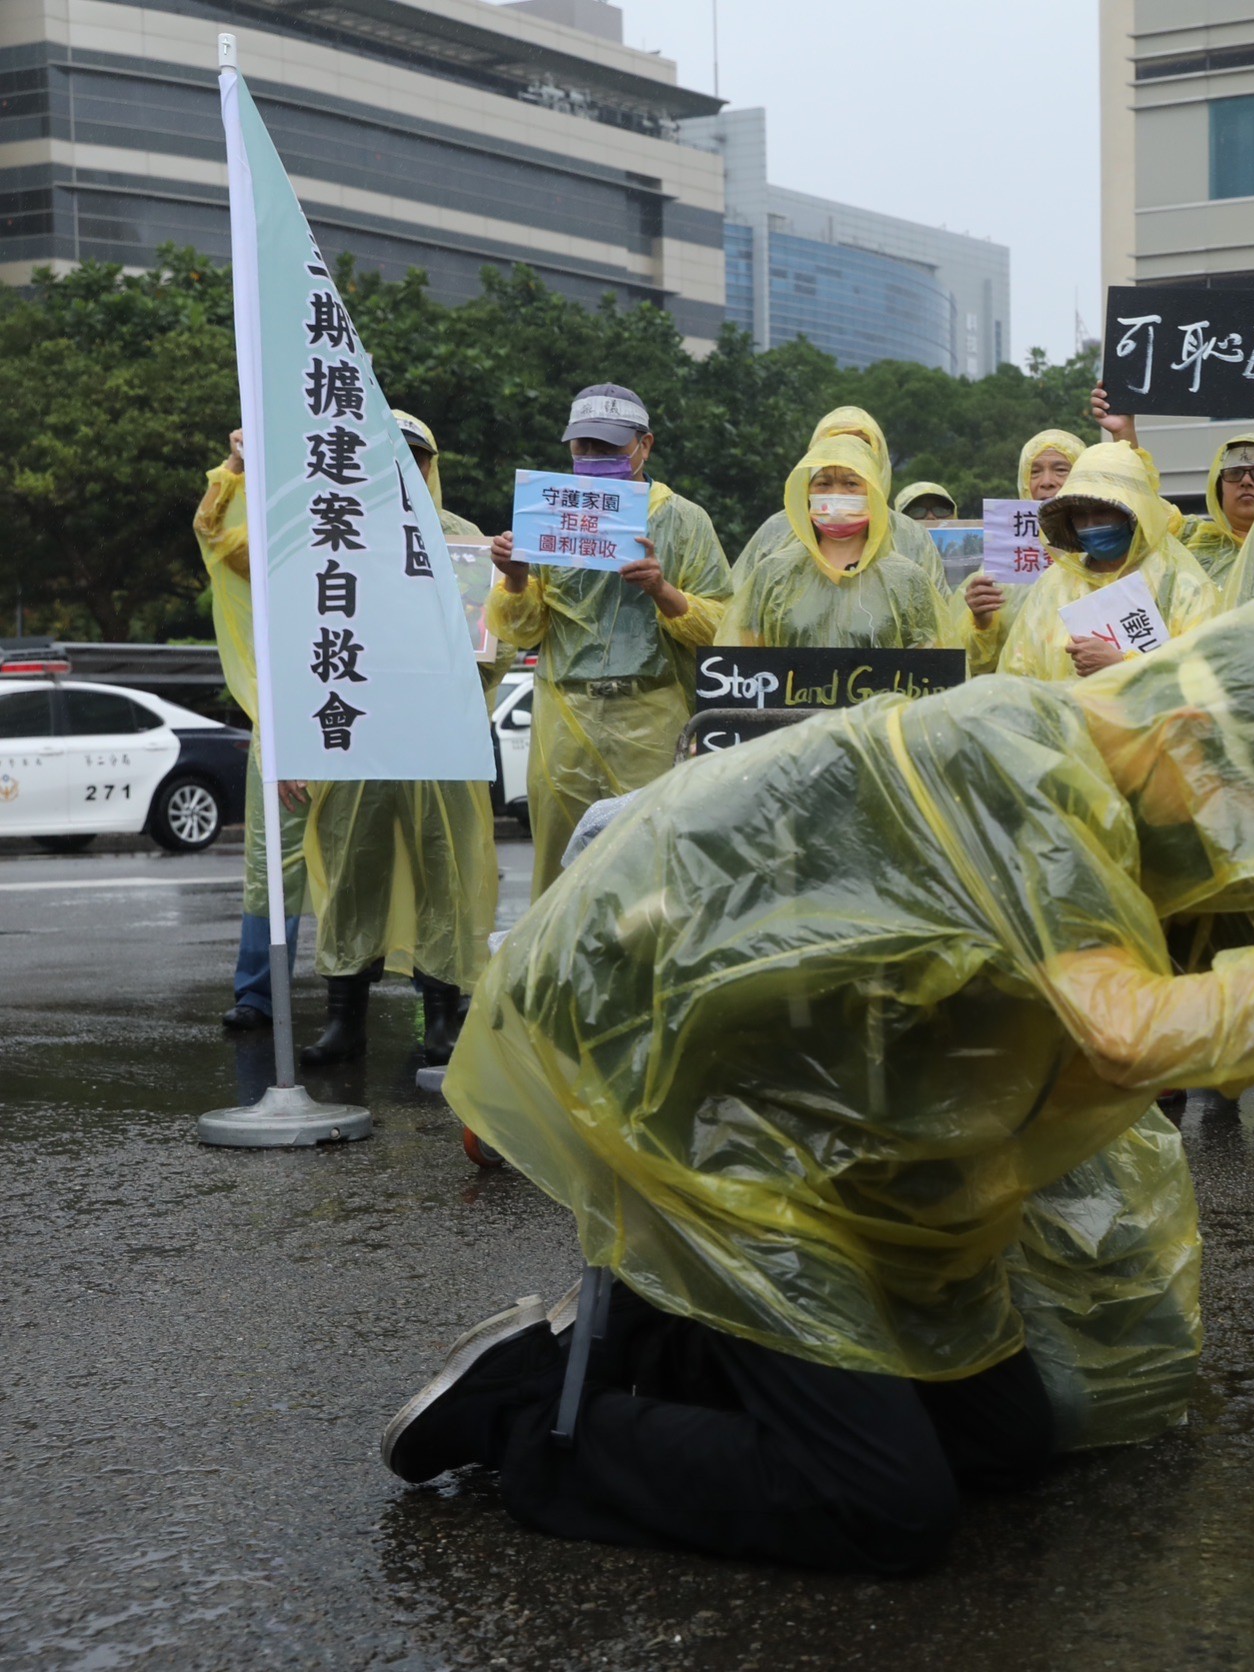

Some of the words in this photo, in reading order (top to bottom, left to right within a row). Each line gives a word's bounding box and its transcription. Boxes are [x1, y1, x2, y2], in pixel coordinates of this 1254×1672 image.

[541, 487, 620, 512] 守護家園
[560, 512, 599, 534] 拒絕
[538, 534, 618, 560] 圖利徵收
[696, 656, 780, 709] Stop
[784, 668, 839, 706] Land
[84, 784, 131, 801] 271
